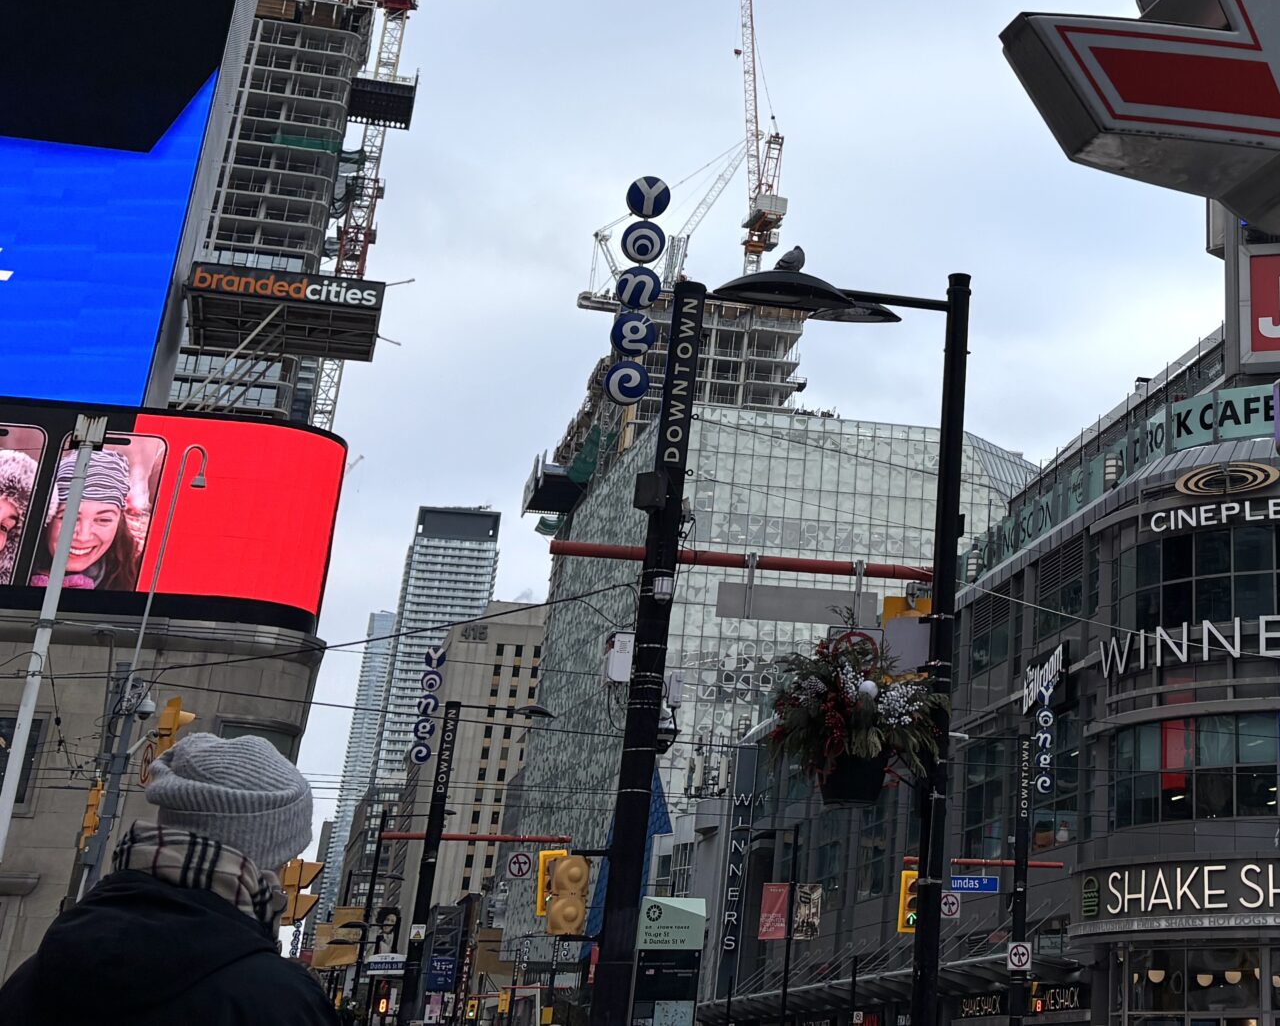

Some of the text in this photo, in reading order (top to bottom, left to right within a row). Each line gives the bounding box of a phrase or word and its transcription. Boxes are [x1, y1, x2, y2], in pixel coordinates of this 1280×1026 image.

[192, 266, 378, 307] brandedcities
[604, 177, 670, 405] Yonge
[663, 296, 699, 464] DOWNTOWN
[1199, 396, 1275, 432] CAFE
[461, 624, 488, 641] 415
[410, 645, 446, 765] Yonge
[435, 708, 458, 794] DOWNTOWN
[1020, 740, 1030, 818] DOWNTOWN
[723, 793, 752, 951] WINNERS
[951, 878, 980, 889] undas
[1107, 865, 1229, 915] SHAKE
[1208, 915, 1233, 927] HOT
